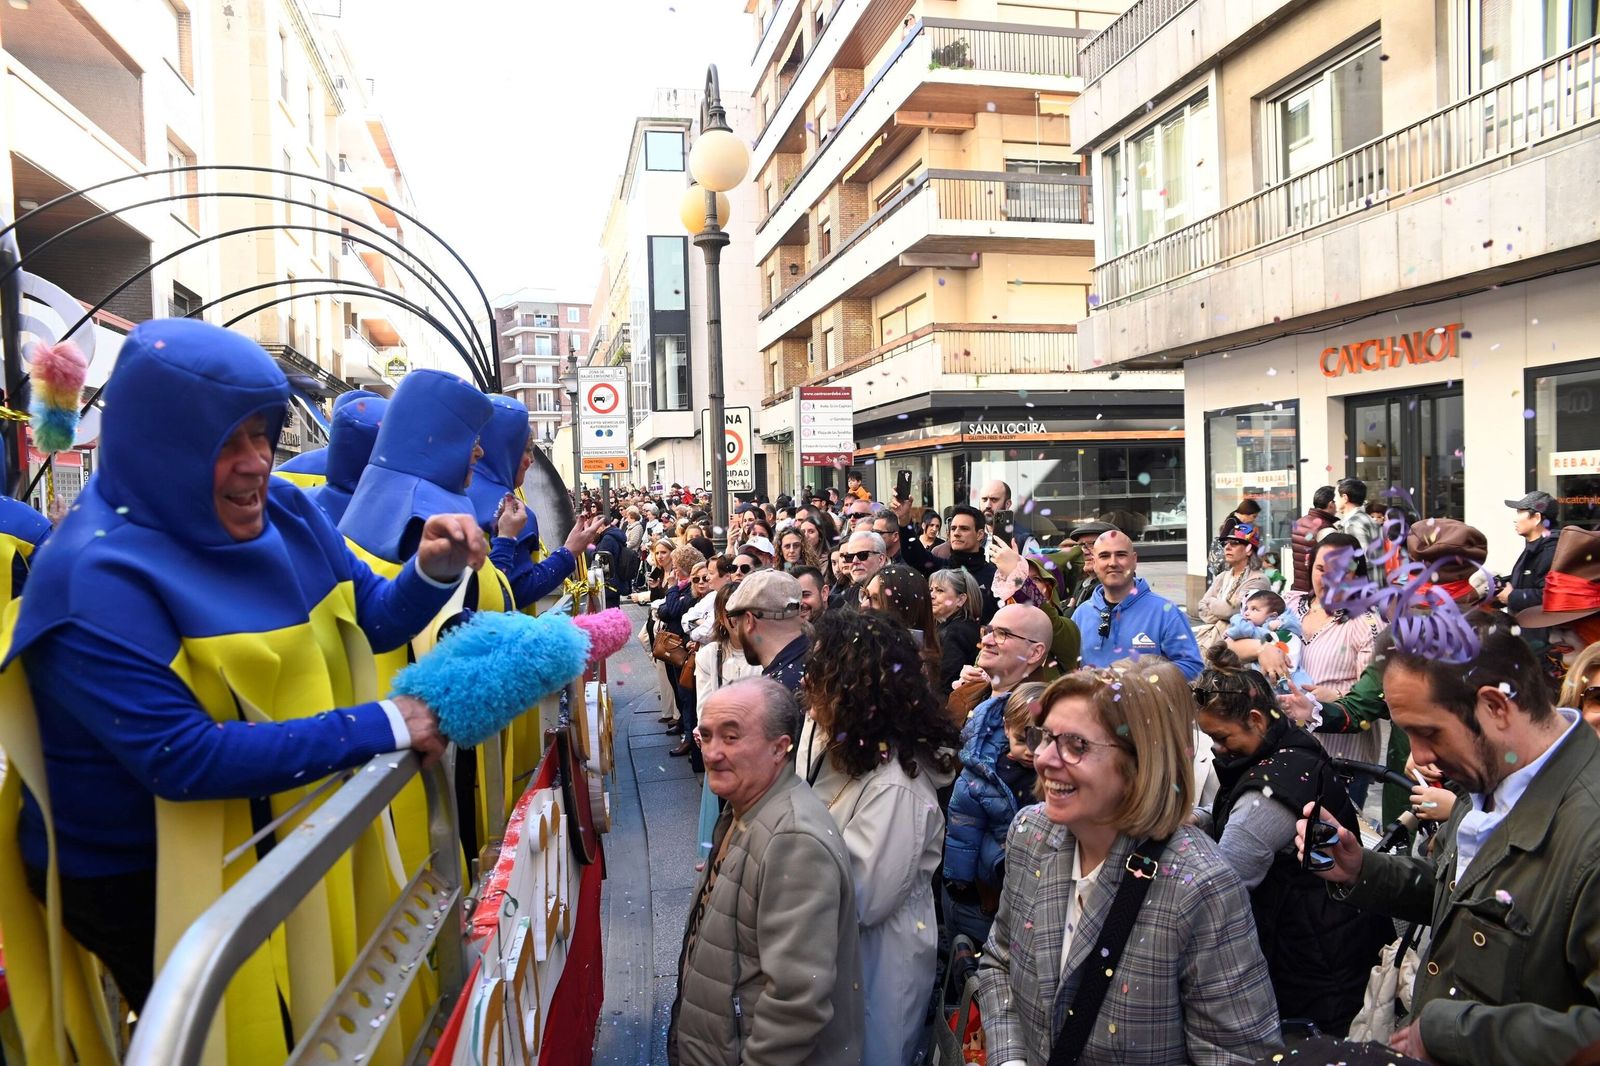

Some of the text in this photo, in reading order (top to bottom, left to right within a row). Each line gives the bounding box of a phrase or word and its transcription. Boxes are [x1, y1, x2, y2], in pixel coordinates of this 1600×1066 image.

[1319, 322, 1463, 377] CATCHALOT
[725, 414, 742, 424] NA
[968, 422, 1048, 435] SANA LOCURA
[1553, 457, 1600, 468] REBAJ
